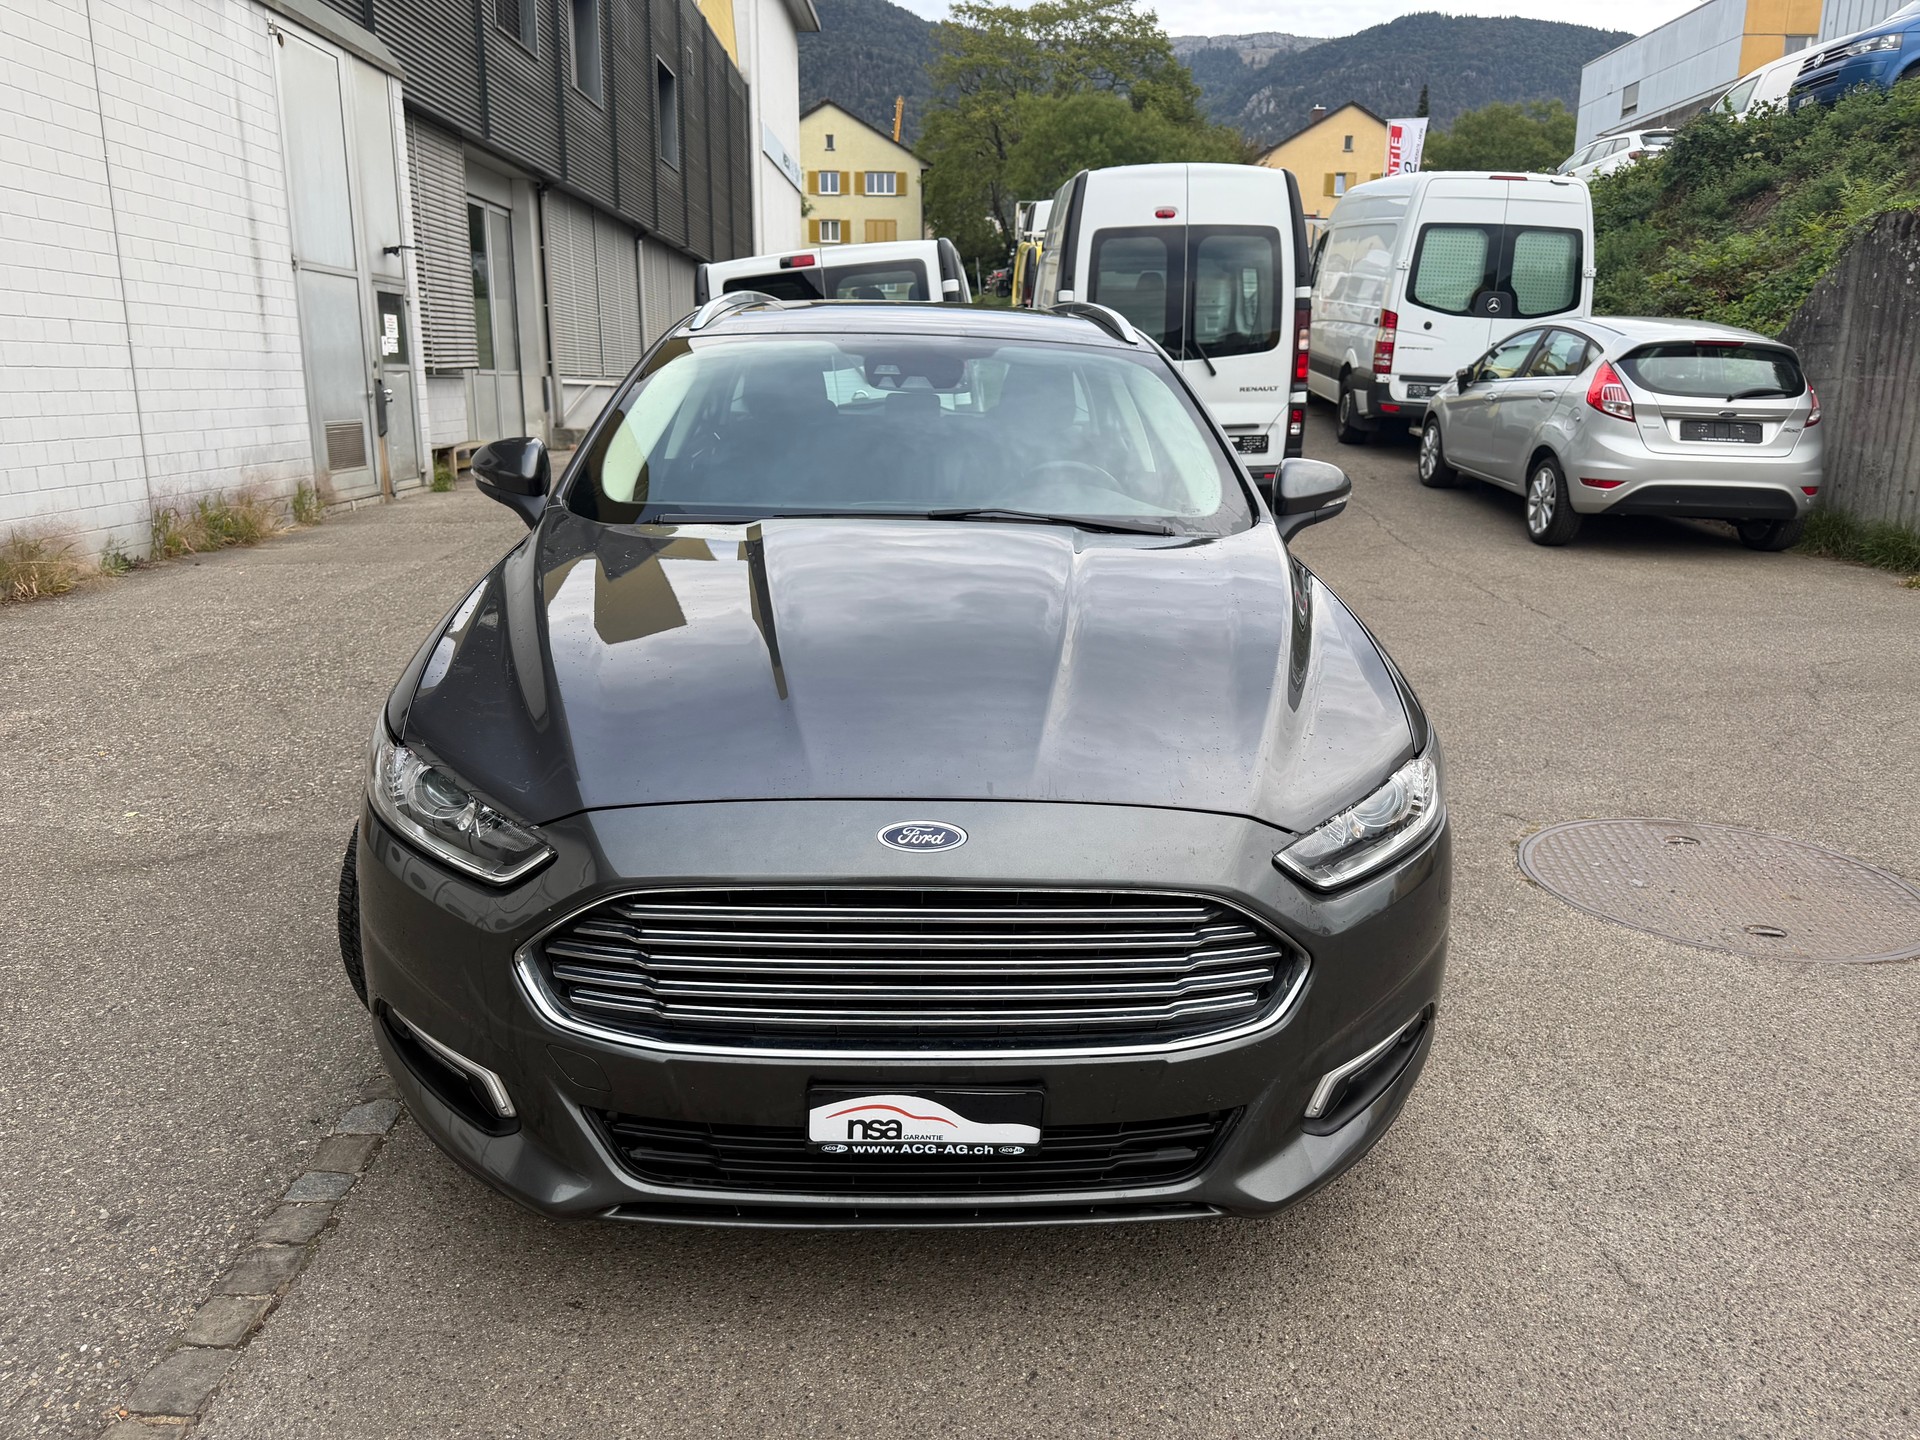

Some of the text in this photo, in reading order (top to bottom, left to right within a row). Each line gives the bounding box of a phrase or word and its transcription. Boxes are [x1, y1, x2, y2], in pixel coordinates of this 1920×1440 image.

[897, 826, 946, 844] Ford
[847, 1119, 903, 1140] nsa
[852, 1144, 994, 1155] www.ACG-AG.ch
